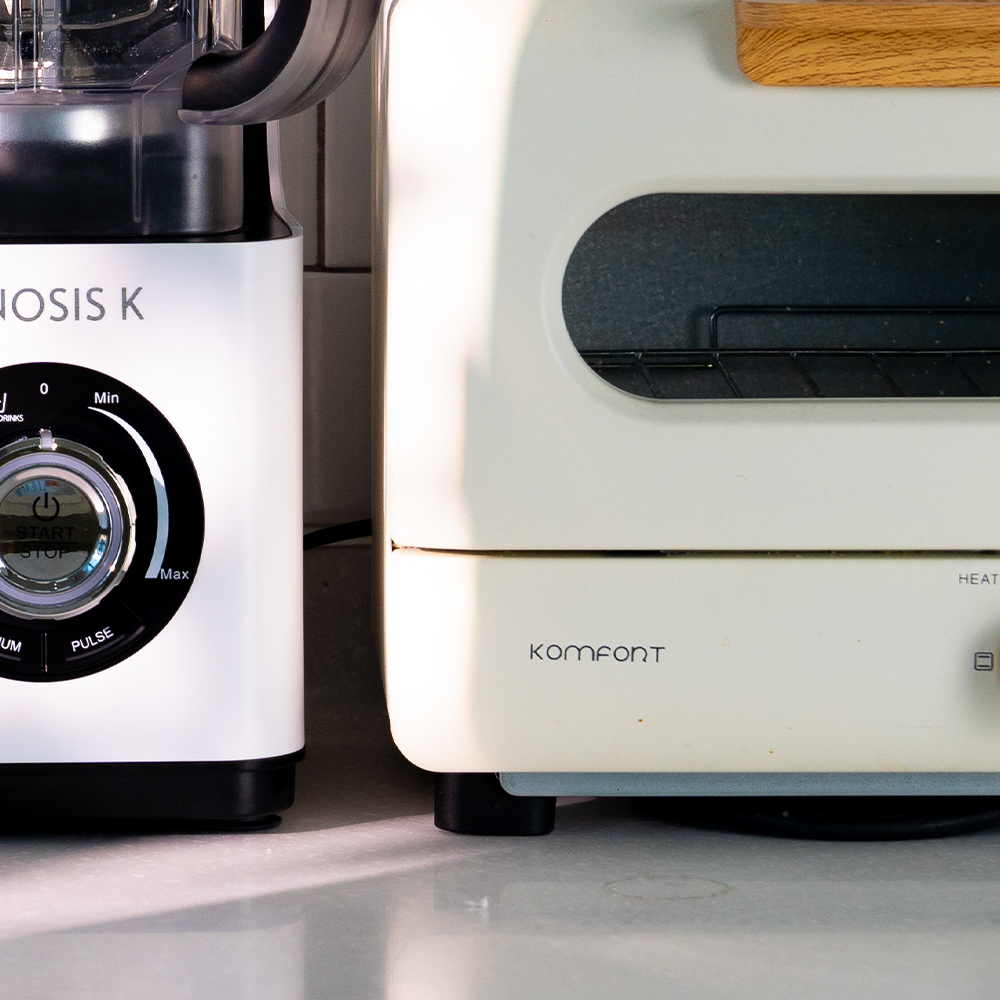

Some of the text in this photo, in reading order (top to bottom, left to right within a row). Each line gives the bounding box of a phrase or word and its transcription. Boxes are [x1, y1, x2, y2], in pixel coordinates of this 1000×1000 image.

[121, 286, 144, 321] K
[39, 382, 49, 395] 0
[94, 391, 119, 404] Min
[16, 526, 75, 541] START
[20, 545, 71, 559] STOP
[160, 568, 189, 580] Max
[958, 573, 1000, 585] HEAT
[70, 626, 115, 652] PULSE
[530, 643, 666, 663] KOMFORT
